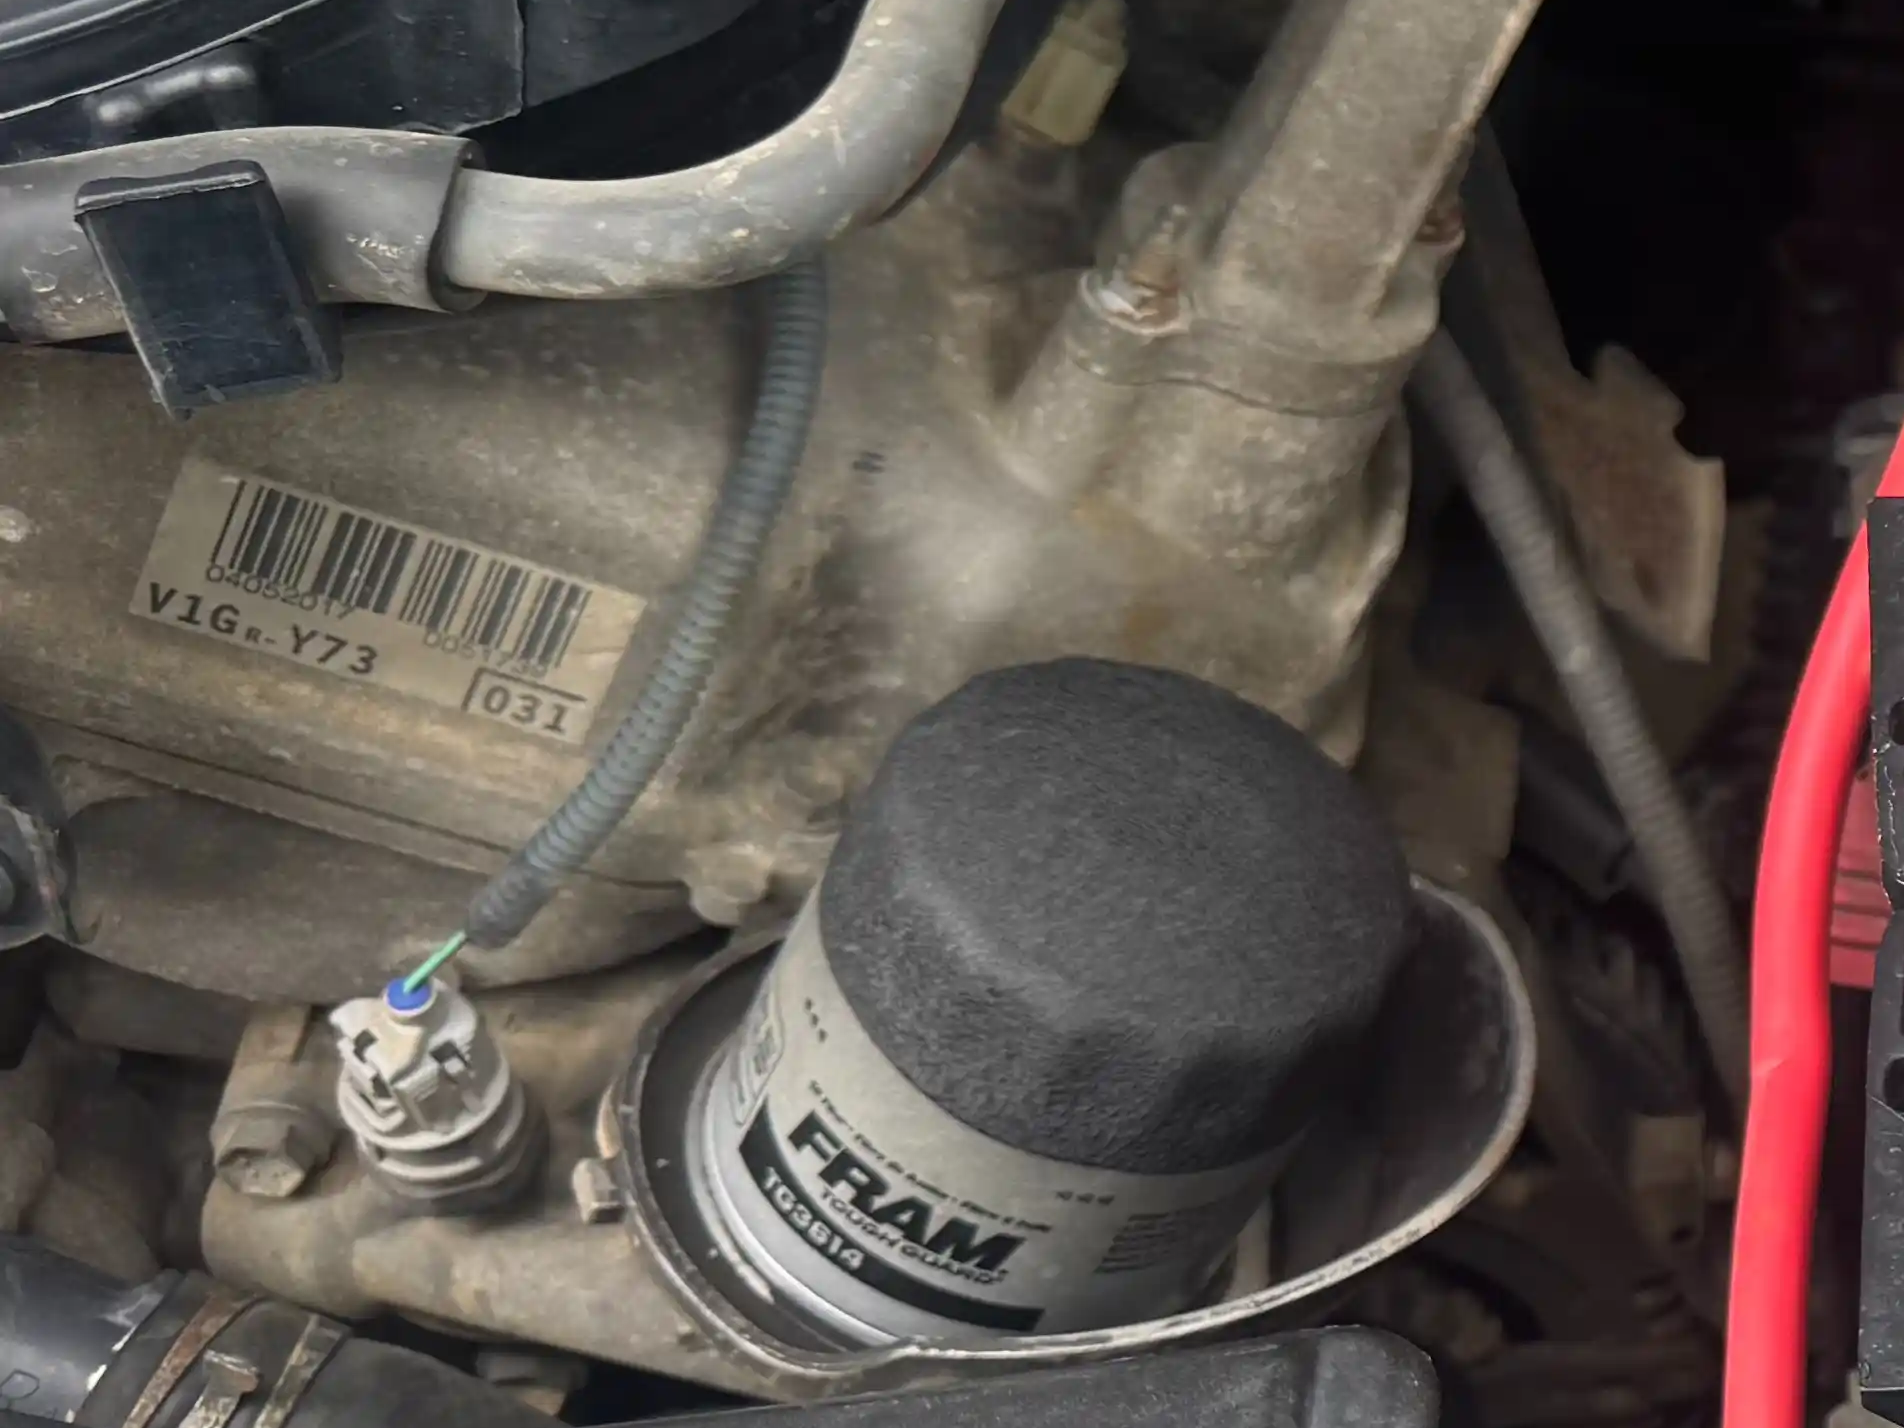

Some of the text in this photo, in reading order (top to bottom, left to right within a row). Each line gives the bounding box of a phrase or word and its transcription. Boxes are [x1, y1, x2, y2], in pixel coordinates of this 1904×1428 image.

[482, 686, 566, 734] 031
[788, 1110, 1027, 1272] FRAM
[821, 1186, 999, 1284] TOUGH GUARD
